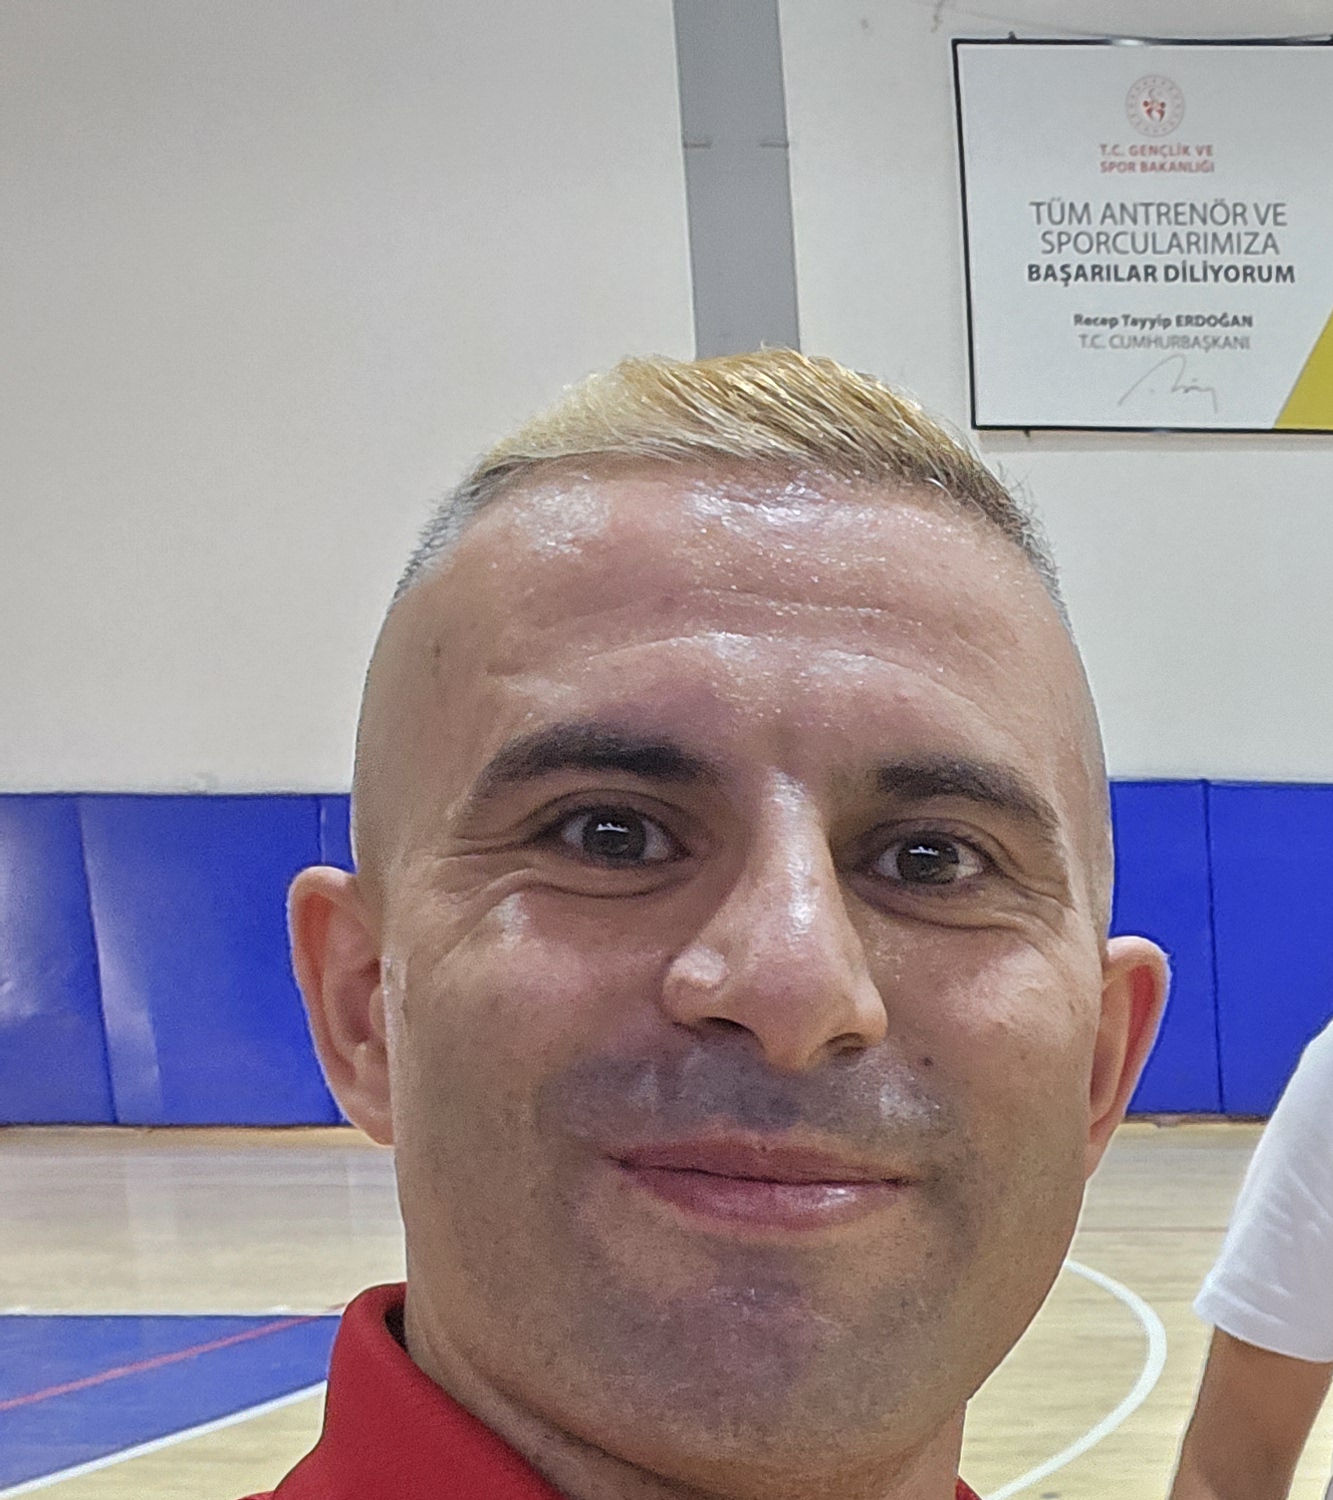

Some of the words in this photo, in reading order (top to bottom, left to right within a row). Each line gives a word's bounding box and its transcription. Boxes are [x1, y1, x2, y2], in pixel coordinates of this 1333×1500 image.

[1100, 144, 1124, 156] T.C.
[1128, 141, 1190, 159] GENÇLİK
[1195, 144, 1214, 156] VE
[1100, 161, 1136, 173] SPOR
[1139, 158, 1215, 173] BAKANLIĞI
[1029, 197, 1092, 226] TÜM
[1099, 198, 1248, 226] ANTRENÖR
[1252, 202, 1287, 226] VE
[1040, 230, 1281, 255] SPORCULARIMIZA
[1027, 264, 1158, 287] BAŞARILAR
[1163, 260, 1296, 283] DİLİYORUM
[1073, 314, 1118, 330] Recep
[1121, 314, 1172, 331] Tayyip
[1175, 312, 1254, 328] ERDOĞAN
[1078, 334, 1104, 350] T.C.
[1108, 334, 1251, 353] CUMHURBAŞKANI
